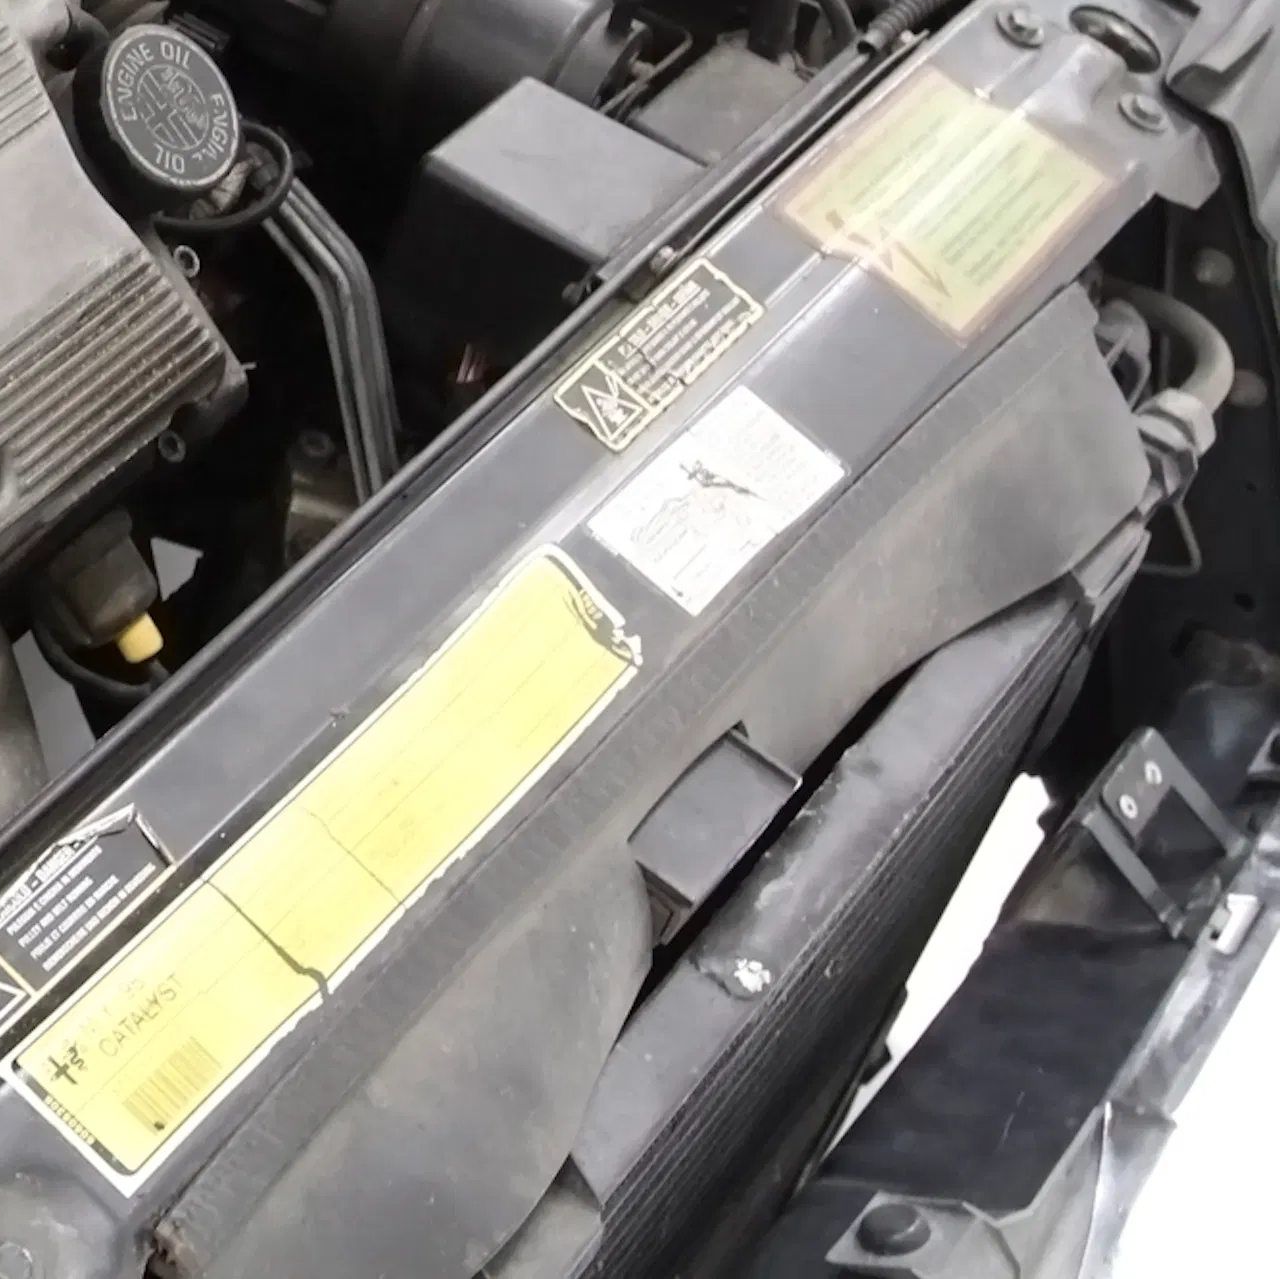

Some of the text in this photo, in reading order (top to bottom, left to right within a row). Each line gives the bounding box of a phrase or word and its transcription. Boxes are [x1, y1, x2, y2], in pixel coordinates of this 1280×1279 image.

[116, 41, 192, 122] ENGINE OIL
[98, 971, 183, 1057] CATALYST
